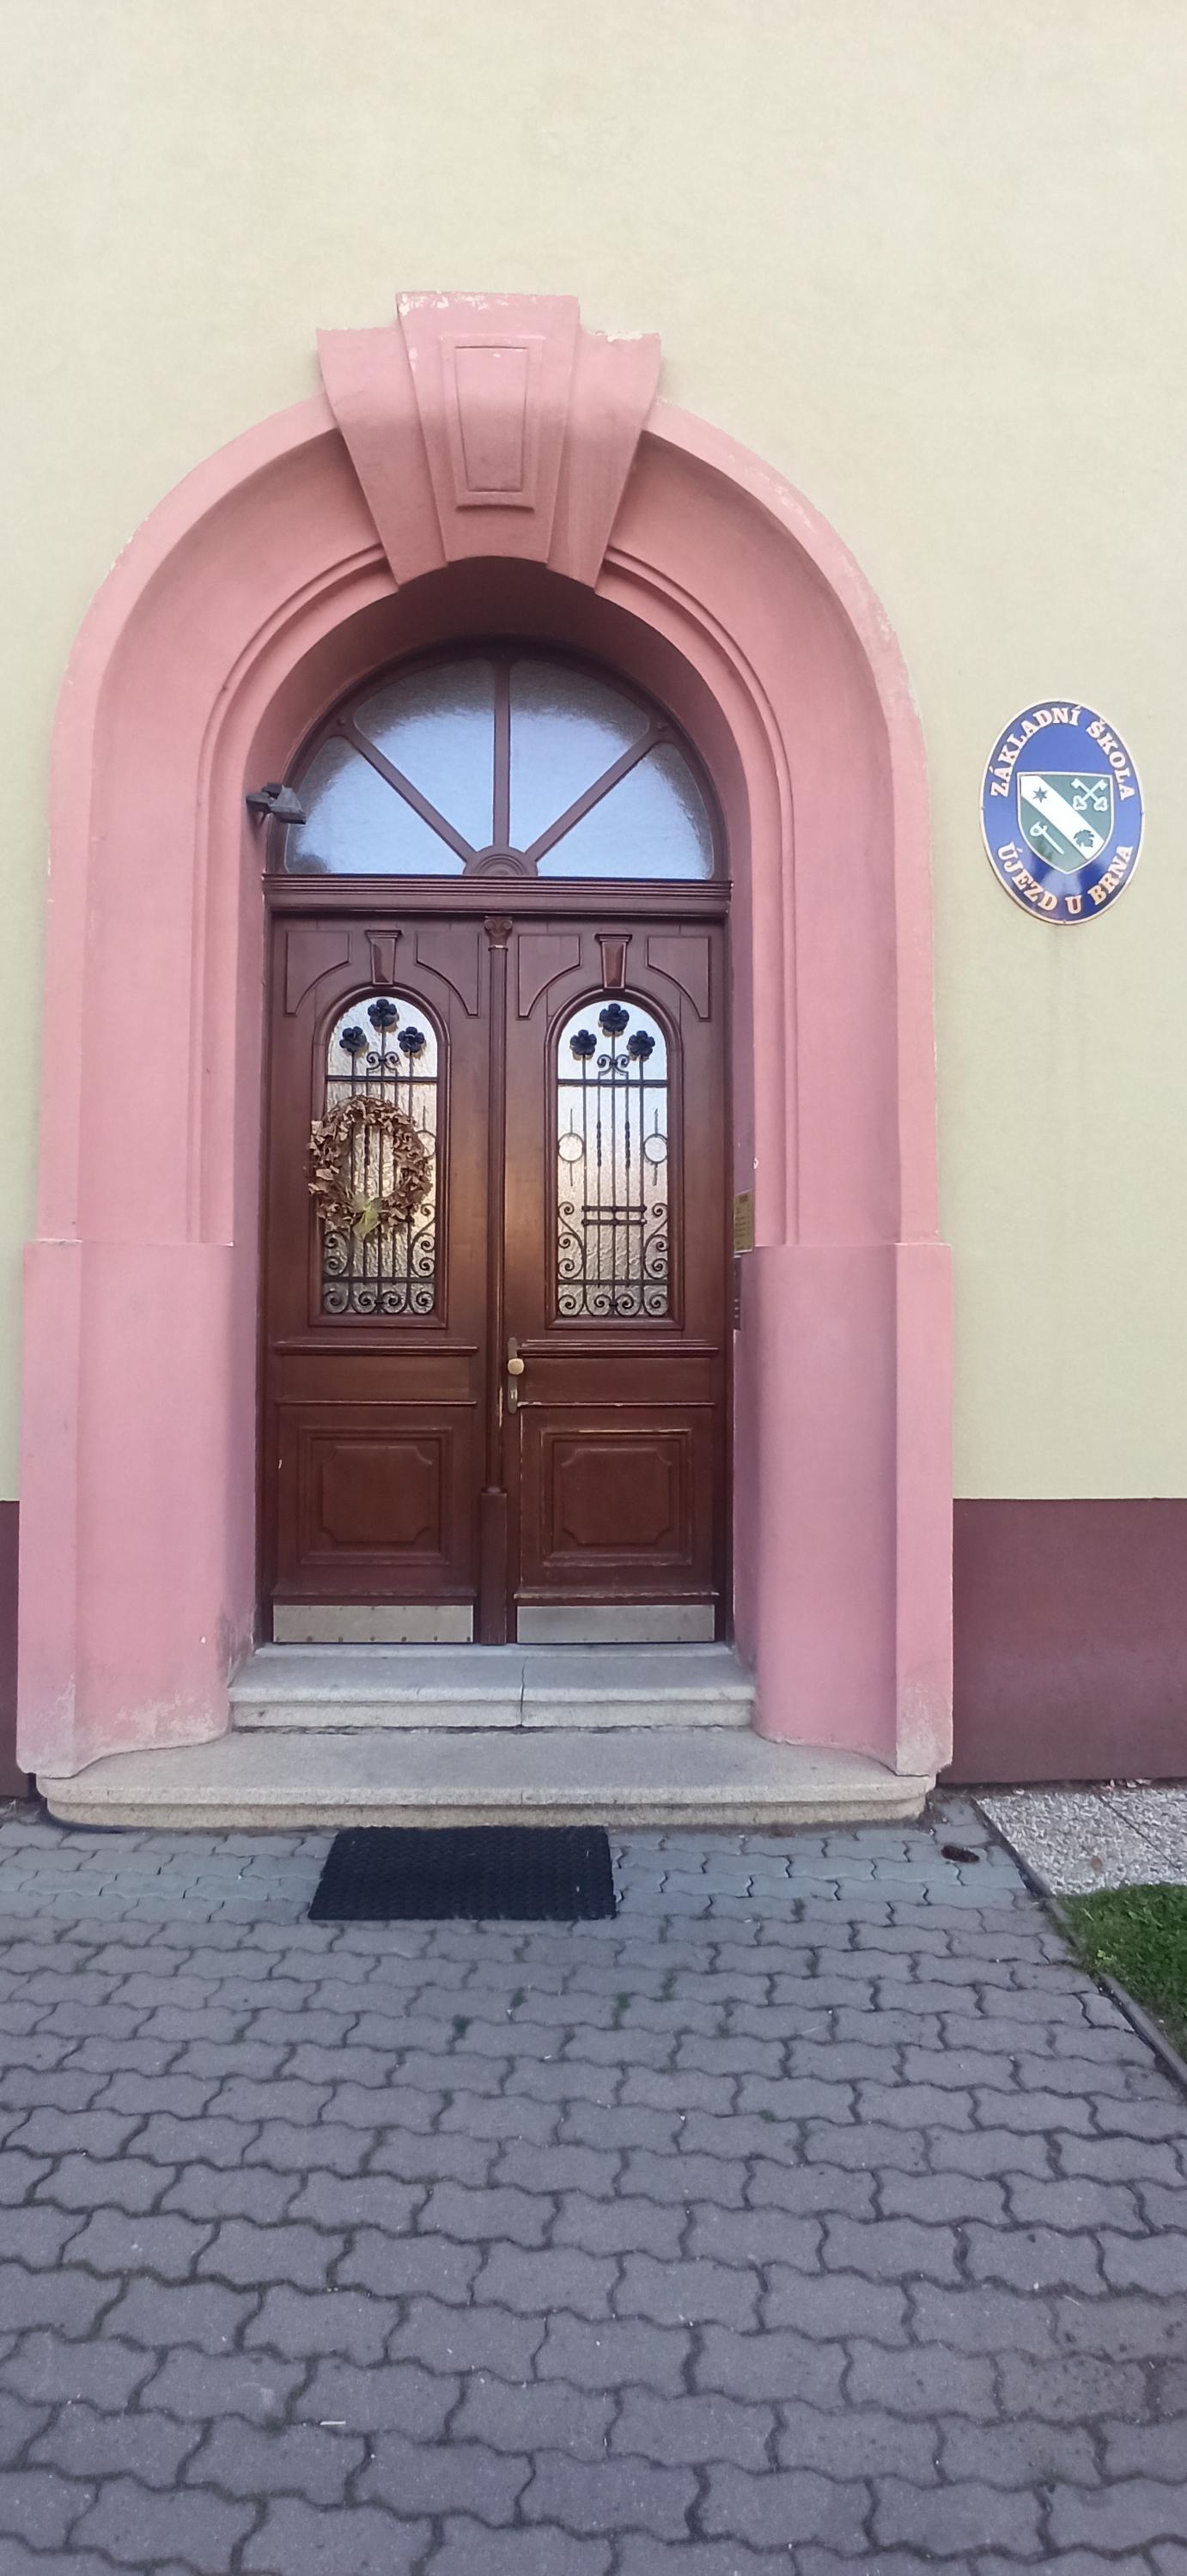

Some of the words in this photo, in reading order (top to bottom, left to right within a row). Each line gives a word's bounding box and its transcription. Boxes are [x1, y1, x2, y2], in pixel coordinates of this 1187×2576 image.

[989, 705, 1081, 798] ZÁKLADNÍ
[1086, 716, 1135, 800] ŠKOLA
[997, 841, 1057, 912] ÚJEZD
[1065, 895, 1082, 914] U
[1087, 845, 1134, 906] BRNA
